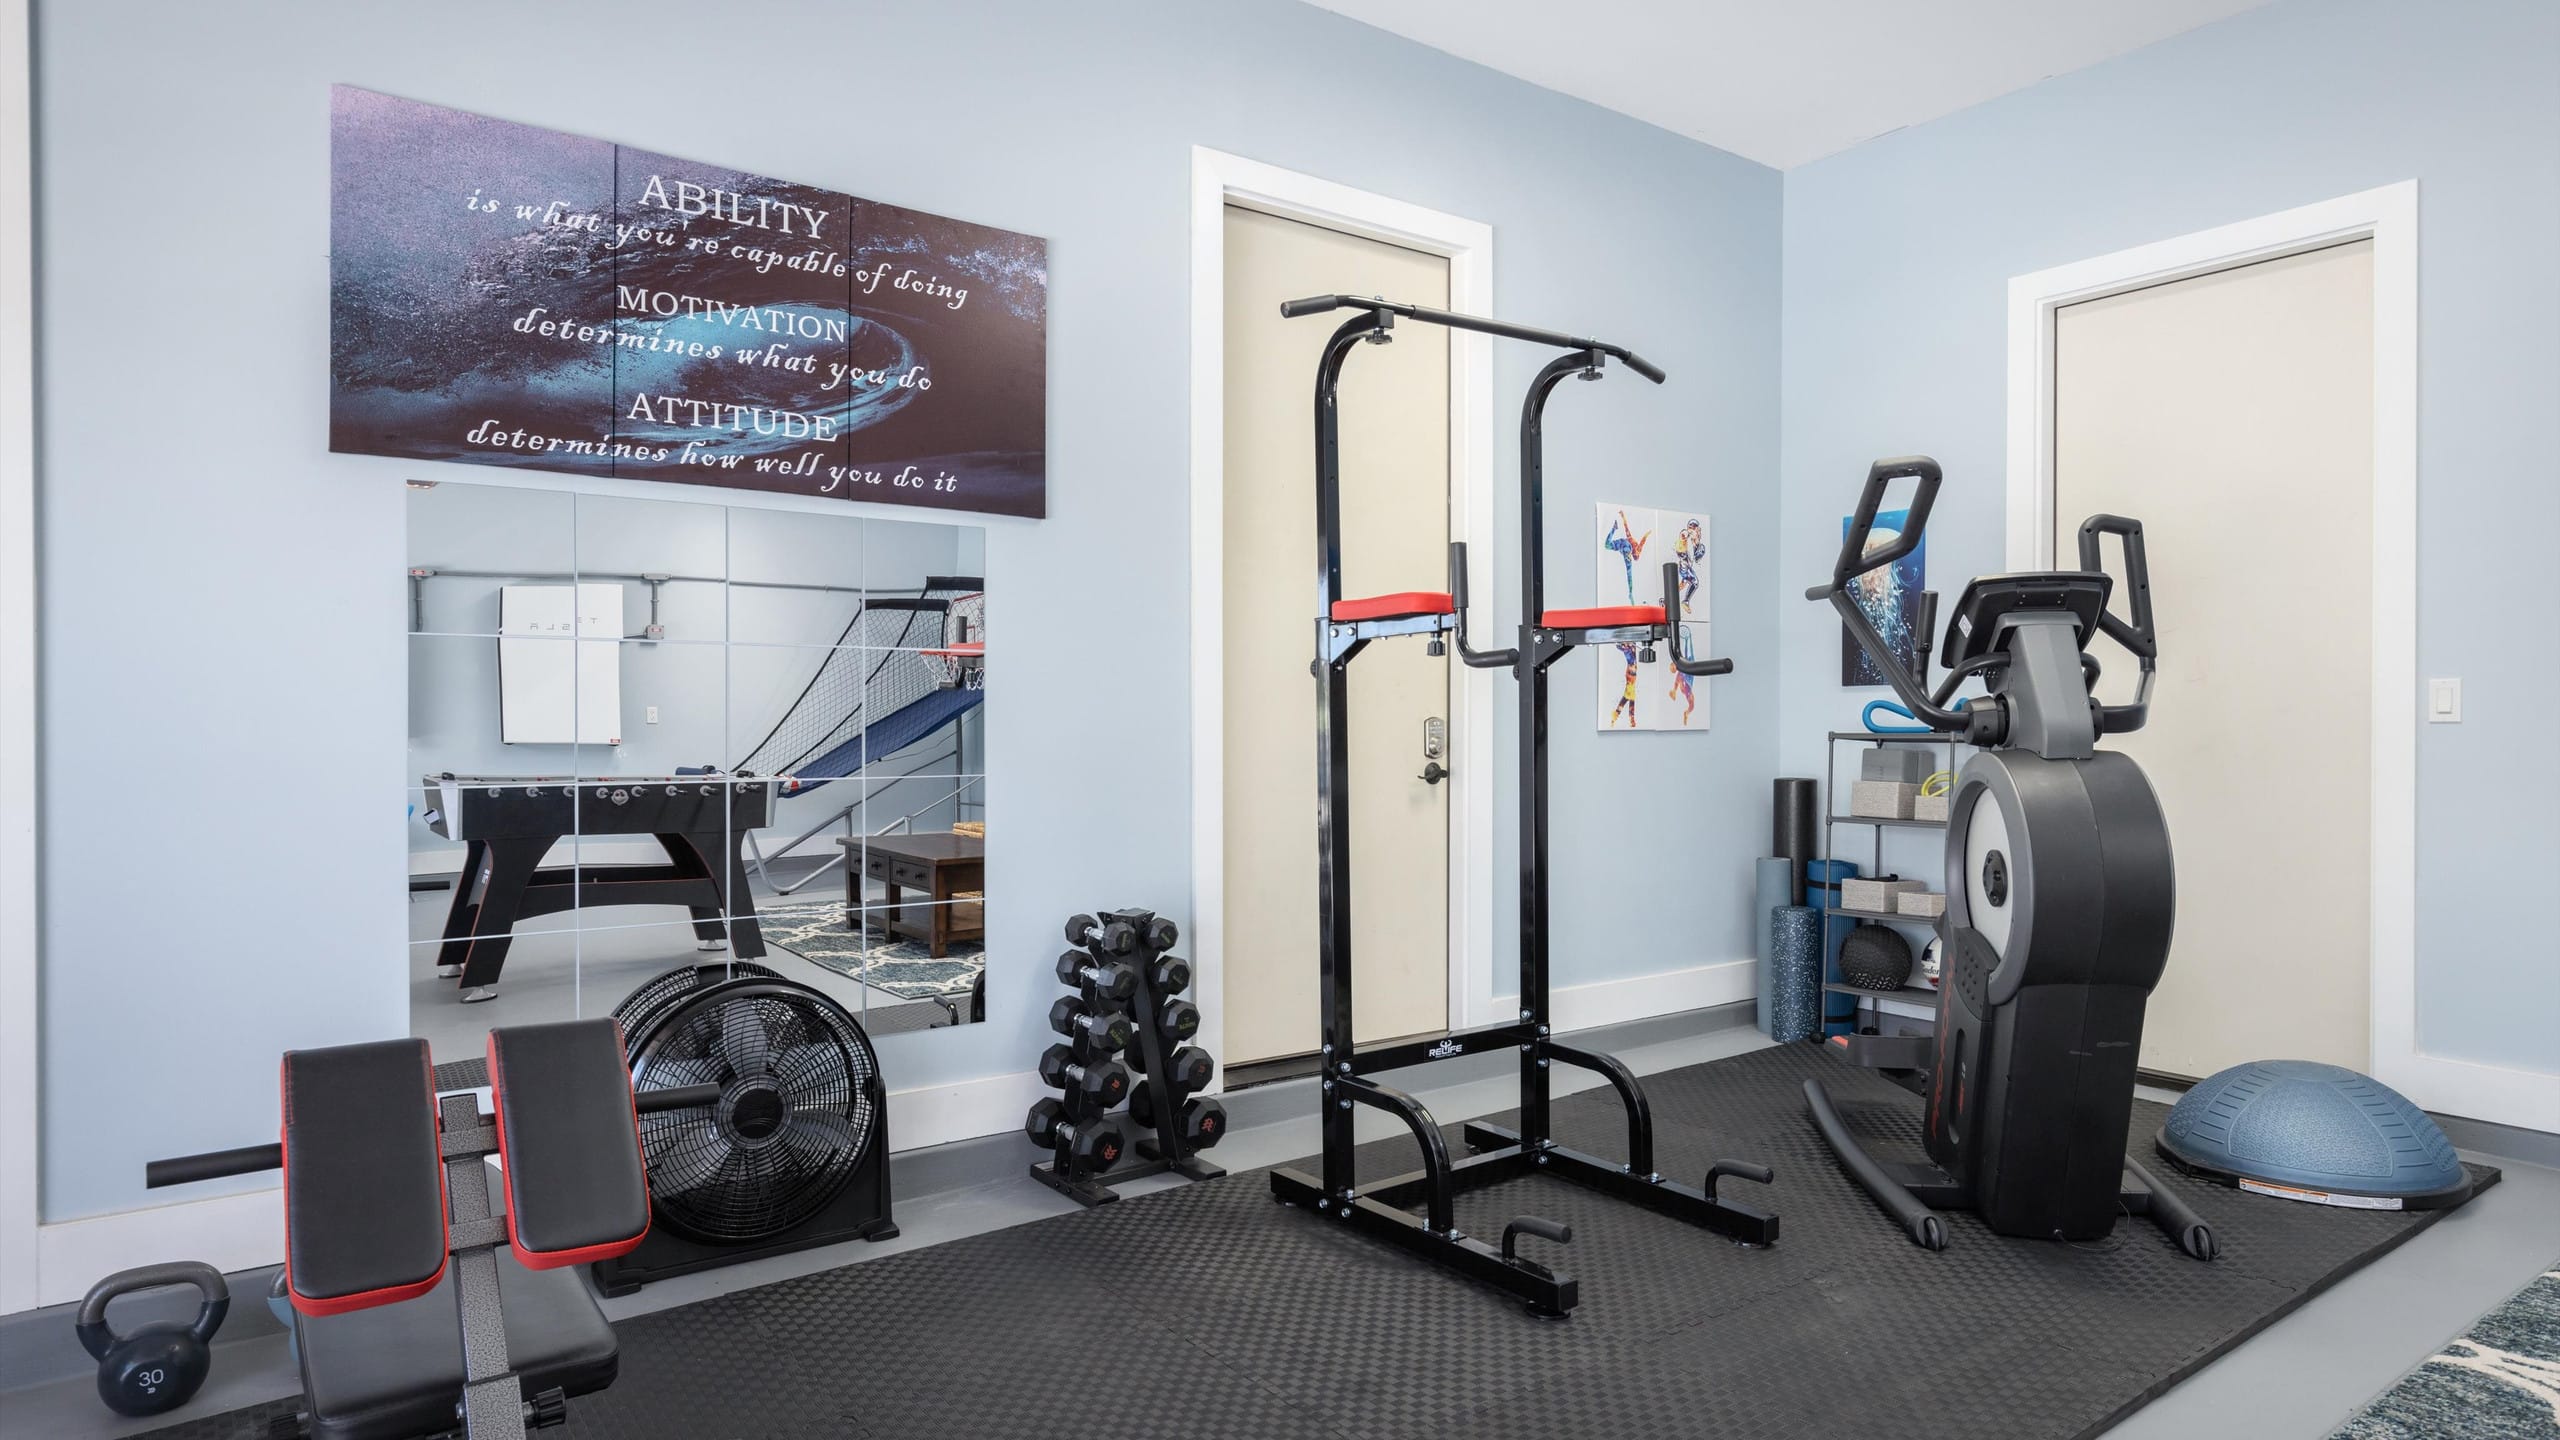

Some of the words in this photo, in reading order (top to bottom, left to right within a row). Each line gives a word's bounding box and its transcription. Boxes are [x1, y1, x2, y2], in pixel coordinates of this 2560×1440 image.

[638, 174, 830, 240] ABILITY
[466, 189, 500, 214] is
[514, 200, 600, 233] what
[604, 219, 720, 255] you're
[730, 244, 847, 278] capable
[855, 262, 892, 295] of
[893, 269, 969, 311] doing
[616, 285, 847, 343] MOTIVATION
[512, 308, 724, 361] determines
[736, 343, 818, 374] what
[820, 358, 889, 391] you
[898, 365, 932, 392] do
[626, 392, 839, 443] ATTITUDE
[466, 419, 669, 464] determines
[680, 441, 746, 471] how
[755, 451, 825, 477] well
[820, 461, 883, 493] you
[893, 465, 926, 489] do
[934, 471, 959, 493] it
[139, 1368, 165, 1387] 30
